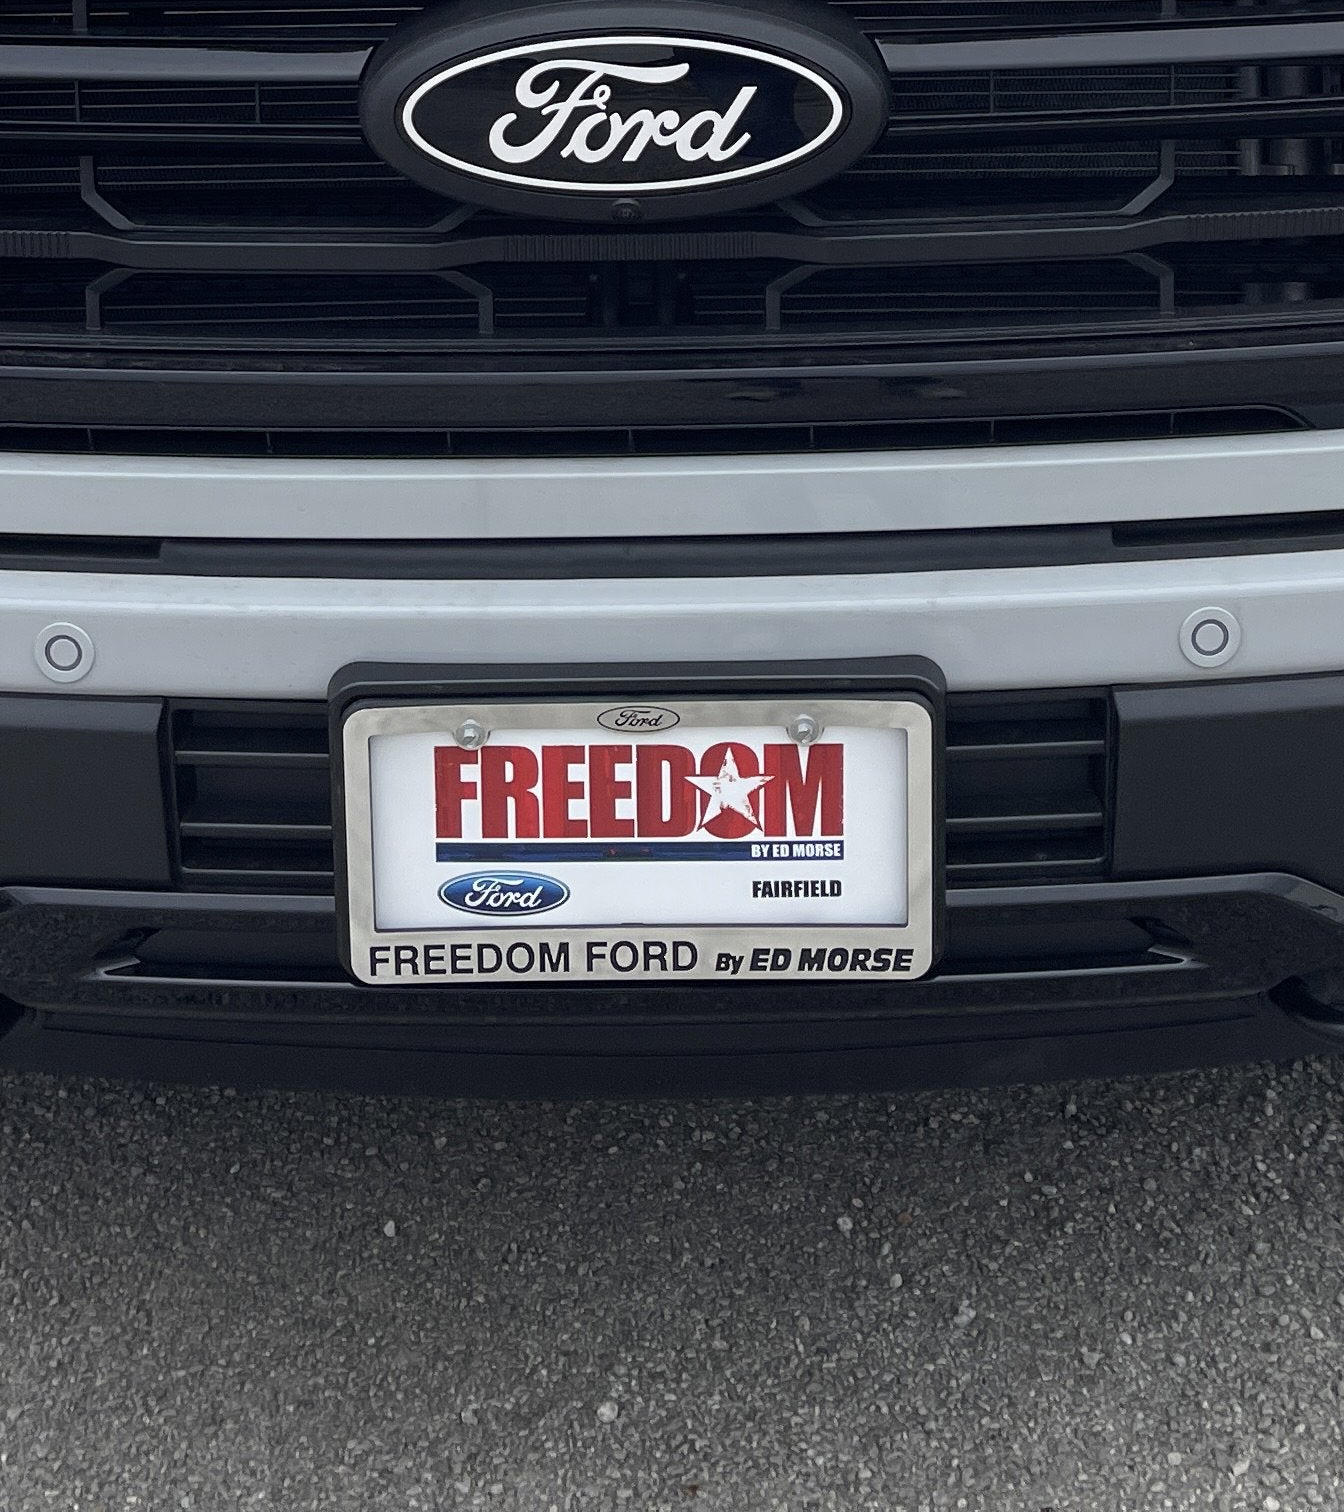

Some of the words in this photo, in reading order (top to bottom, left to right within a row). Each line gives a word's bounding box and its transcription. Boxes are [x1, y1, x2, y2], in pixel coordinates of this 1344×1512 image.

[489, 59, 757, 164] Ford
[613, 706, 664, 728] Ford
[434, 741, 844, 840] FREEDOM
[751, 844, 770, 858] BY
[772, 844, 790, 857] ED
[792, 843, 841, 857] MORSE
[464, 877, 543, 910] Ford
[752, 879, 842, 898] FAIRFIELD
[369, 942, 570, 977] FREEDOM
[586, 941, 698, 974] FORD
[715, 952, 742, 975] By
[749, 948, 793, 972] ED
[797, 948, 914, 973] MORSE
